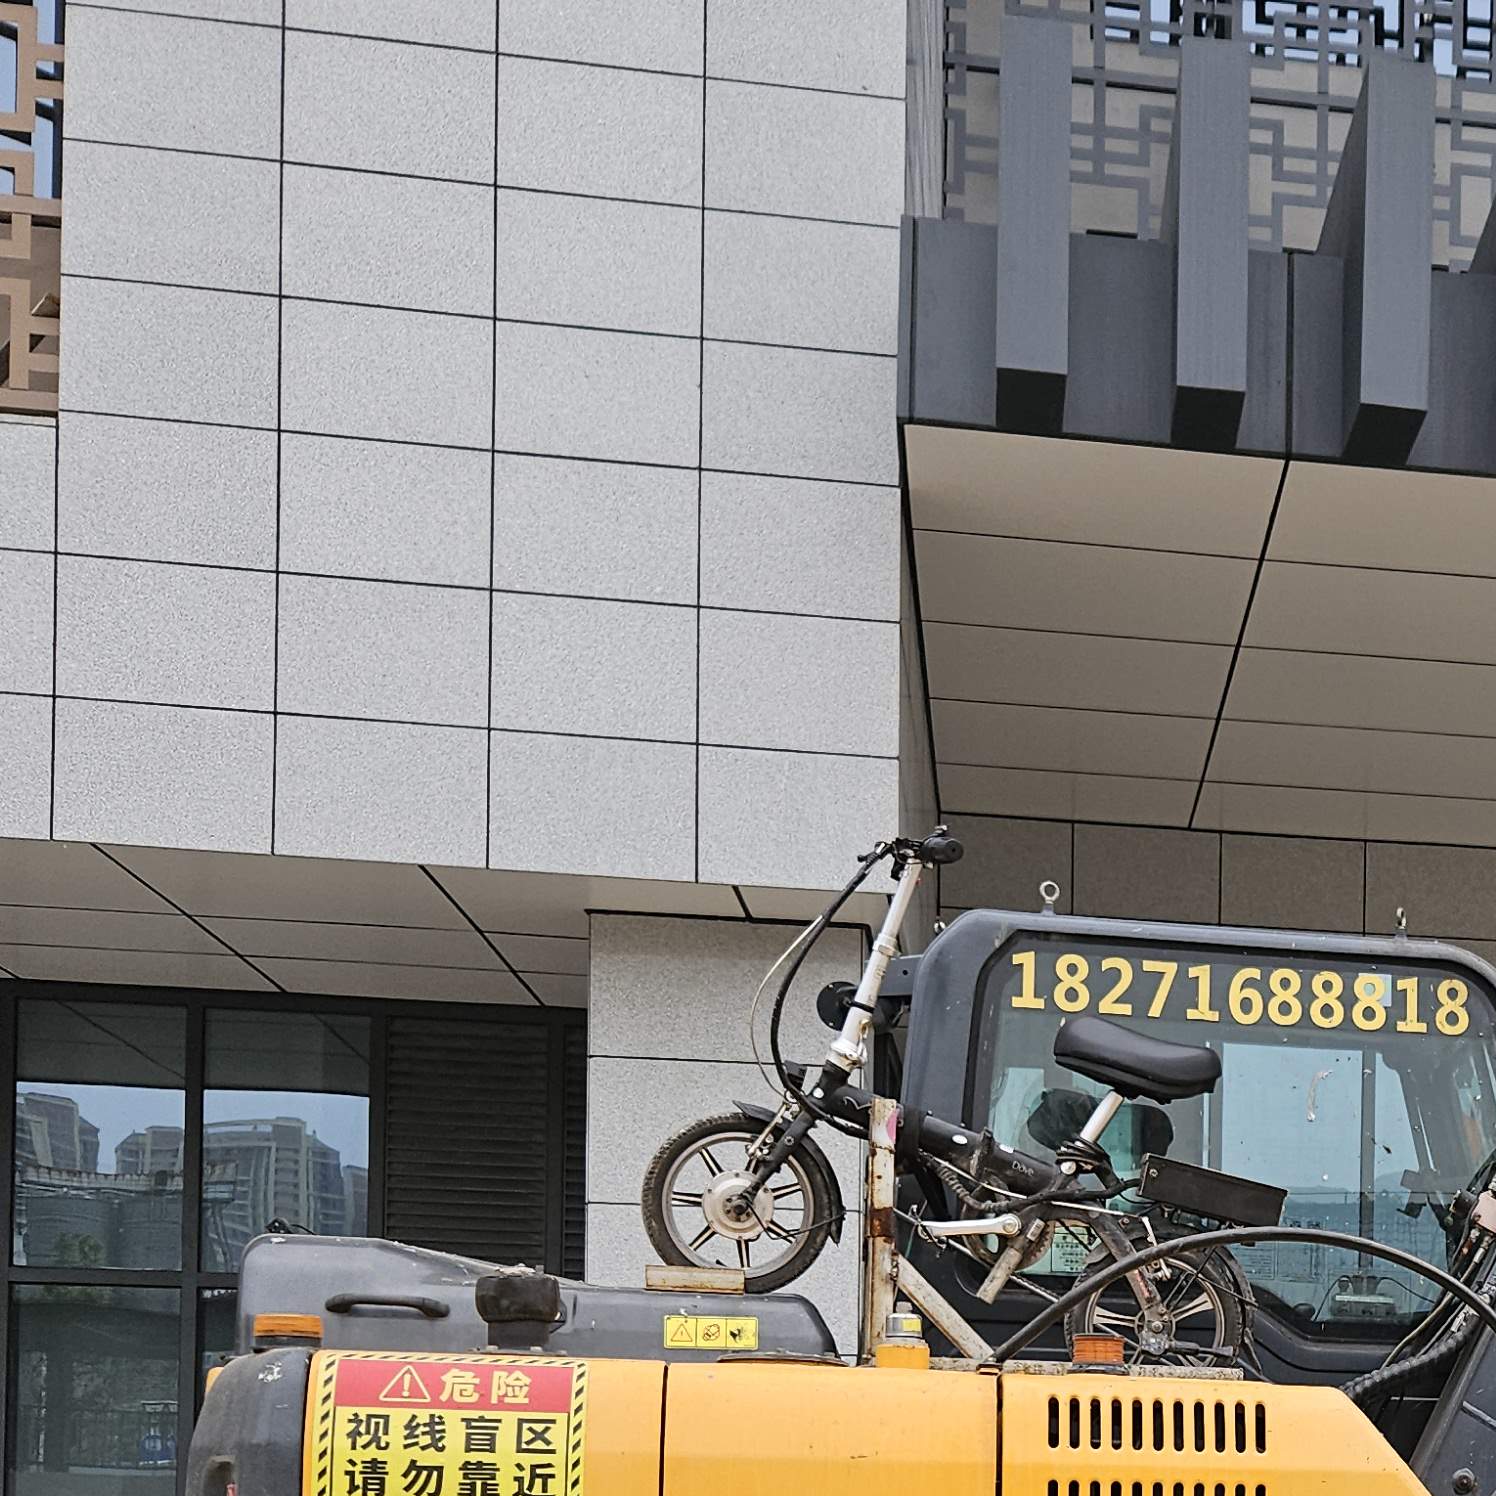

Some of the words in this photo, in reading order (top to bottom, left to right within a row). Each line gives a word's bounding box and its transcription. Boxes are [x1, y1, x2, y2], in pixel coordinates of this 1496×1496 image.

[1011, 951, 1470, 1036] 18271688818
[439, 1368, 532, 1404] 危险
[346, 1412, 557, 1454] 视线盲区
